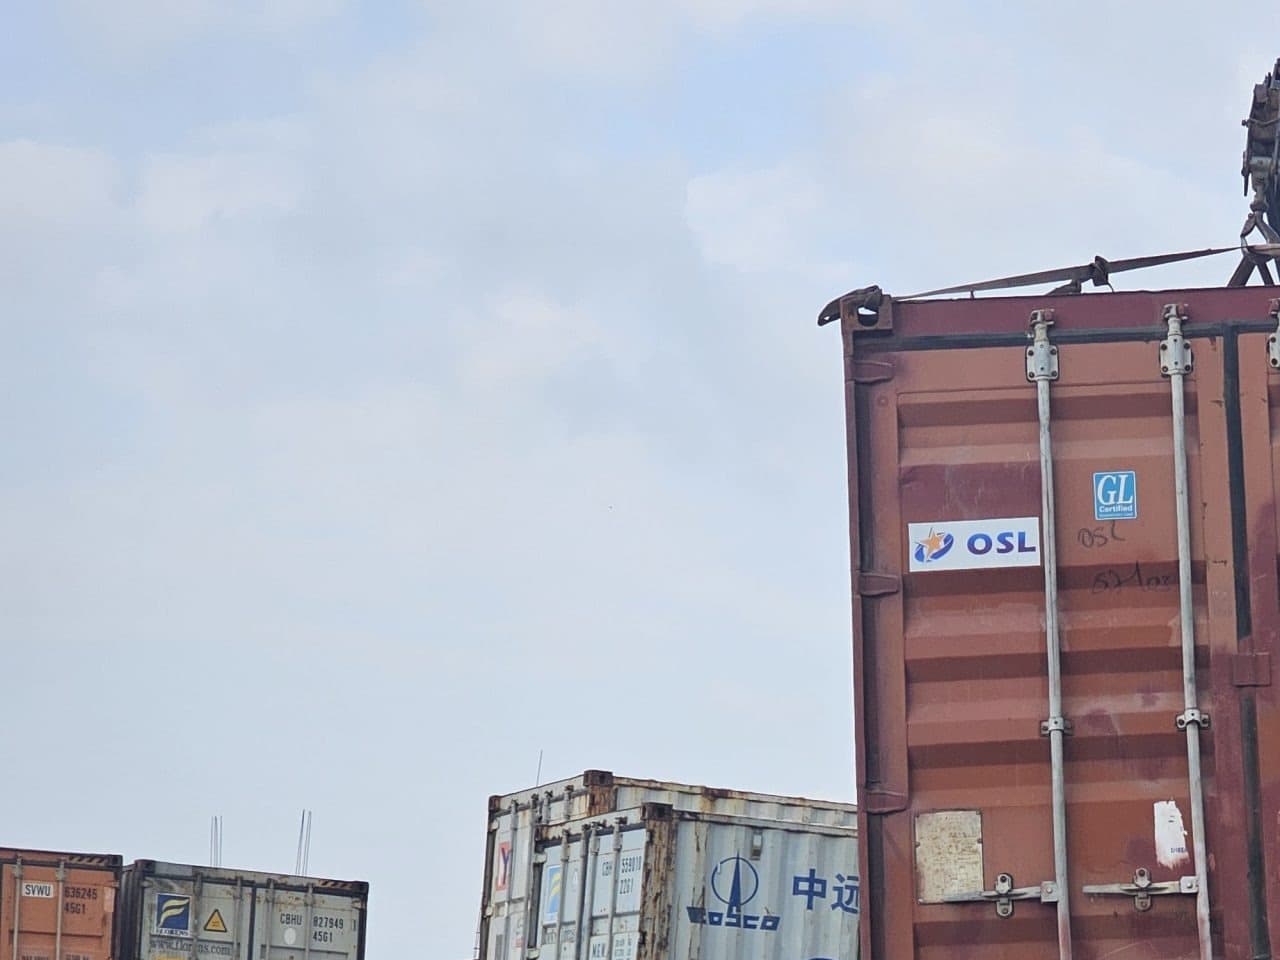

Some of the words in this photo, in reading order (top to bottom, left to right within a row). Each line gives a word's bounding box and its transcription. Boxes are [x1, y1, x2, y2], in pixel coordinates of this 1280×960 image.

[1097, 474, 1134, 505] GL
[1099, 504, 1133, 513] Certified
[967, 531, 1037, 555] OSL
[25, 885, 51, 897] SVWU
[791, 868, 860, 915] 中远
[280, 914, 303, 926] CBHU
[312, 930, 334, 944] 45G1
